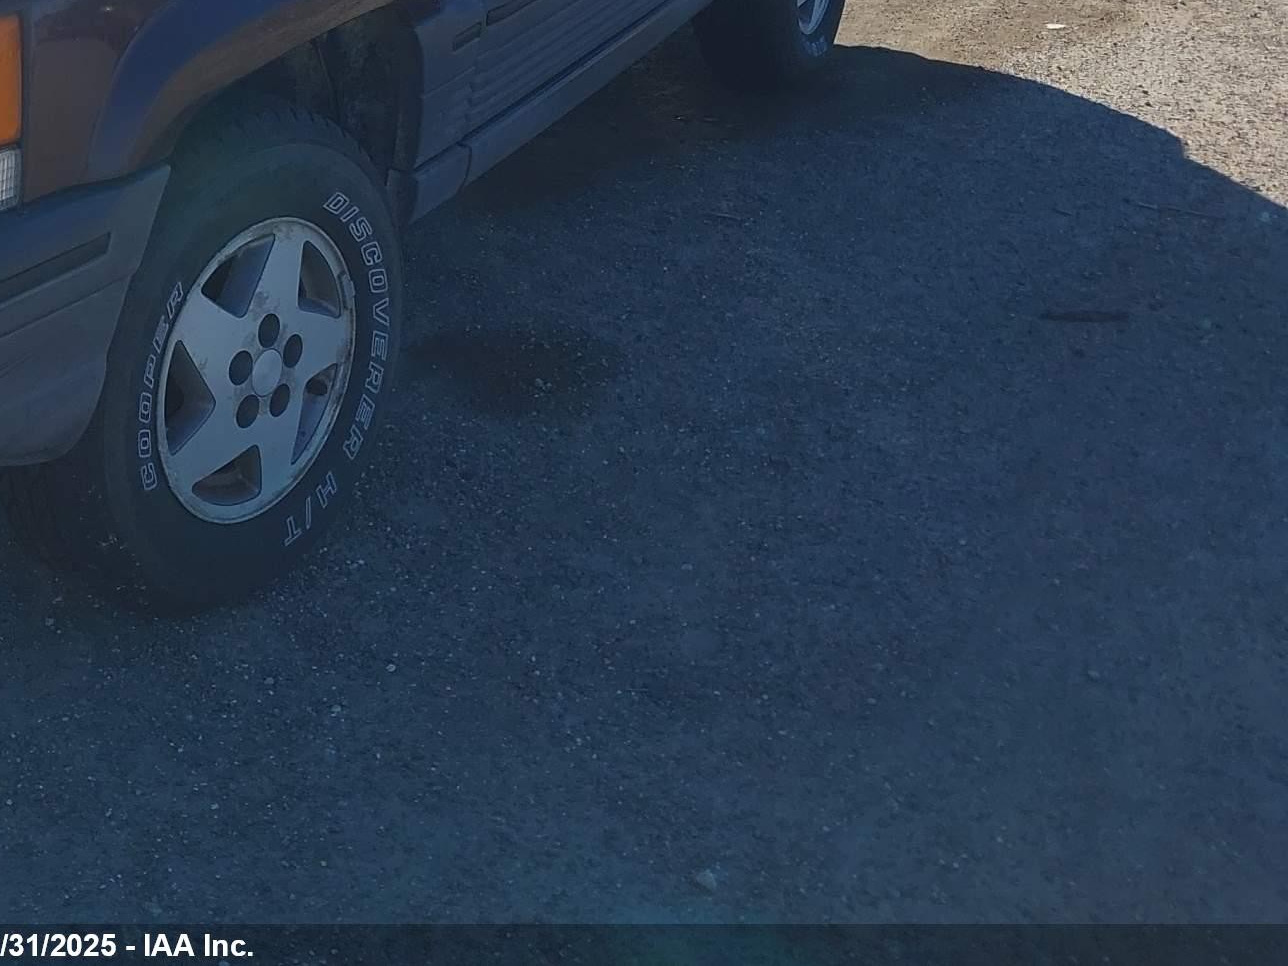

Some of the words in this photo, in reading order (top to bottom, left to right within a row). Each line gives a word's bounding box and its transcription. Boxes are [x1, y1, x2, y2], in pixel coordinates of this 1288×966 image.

[137, 281, 184, 491] COOPER
[323, 192, 390, 460] DISCOVERER
[283, 471, 337, 547] H/T
